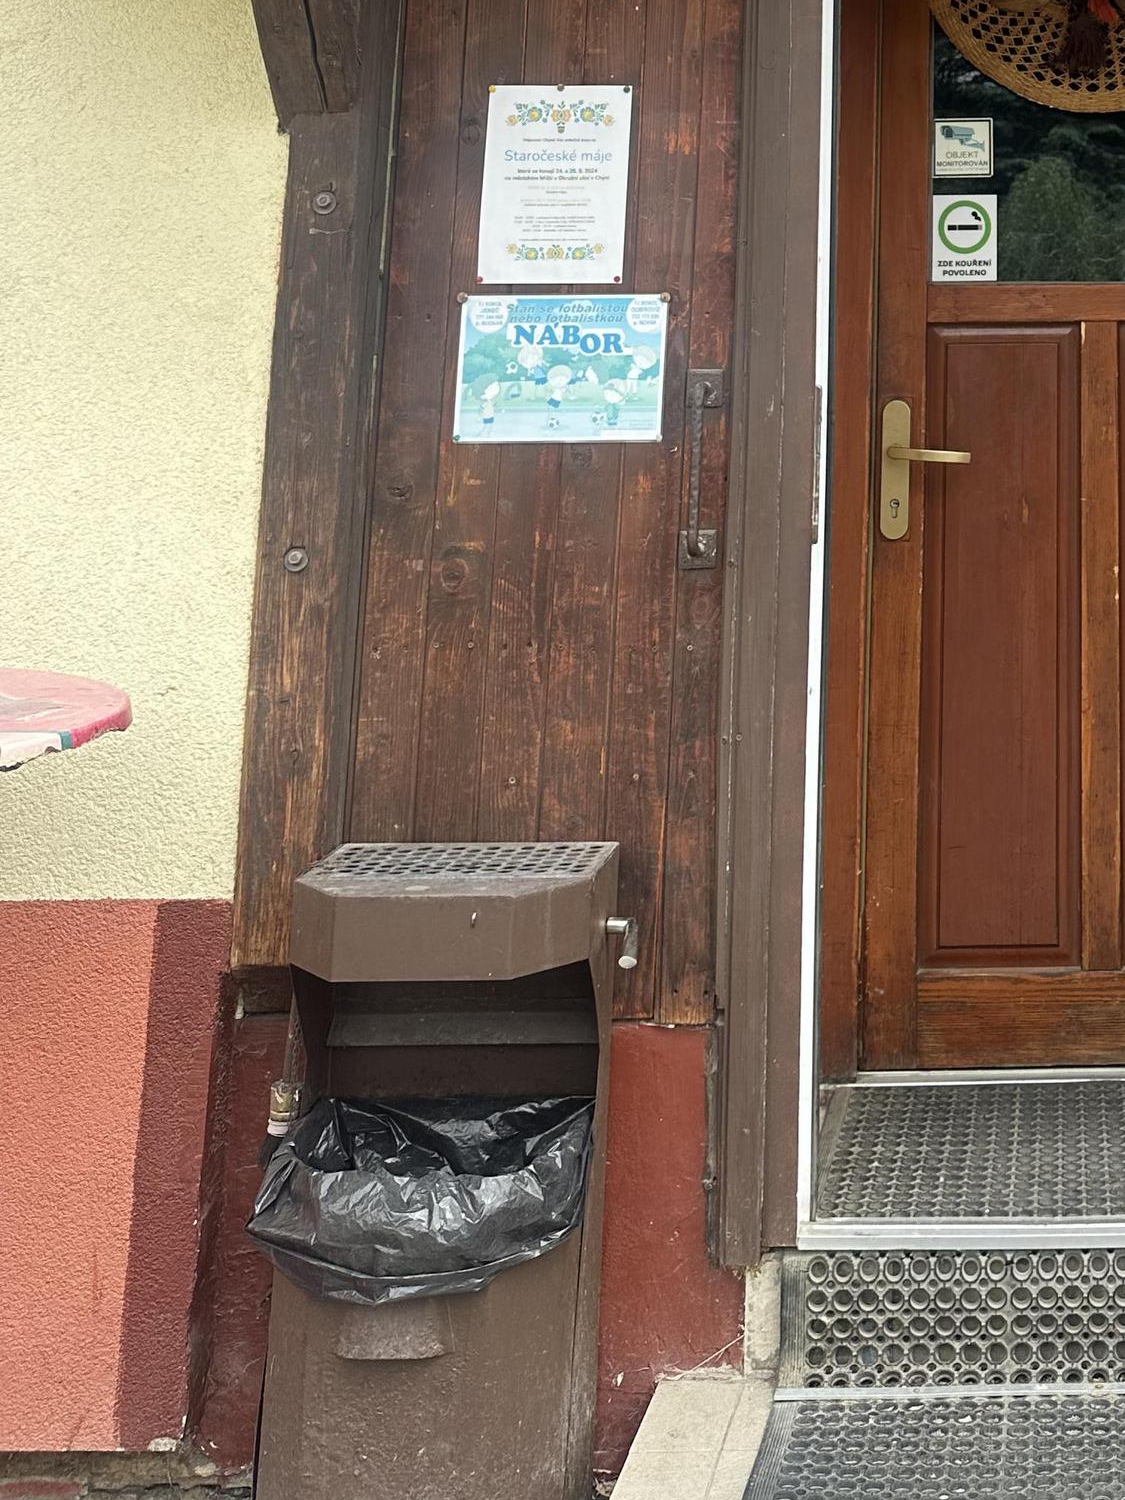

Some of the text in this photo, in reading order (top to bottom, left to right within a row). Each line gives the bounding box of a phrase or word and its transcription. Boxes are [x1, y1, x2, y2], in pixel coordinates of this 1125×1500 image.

[504, 149, 613, 164] Staročeské máje
[945, 151, 978, 159] OBJEKT
[955, 258, 991, 267] KOUŘENÍ
[507, 303, 535, 314] Stan
[513, 321, 624, 354] NÁBOR
